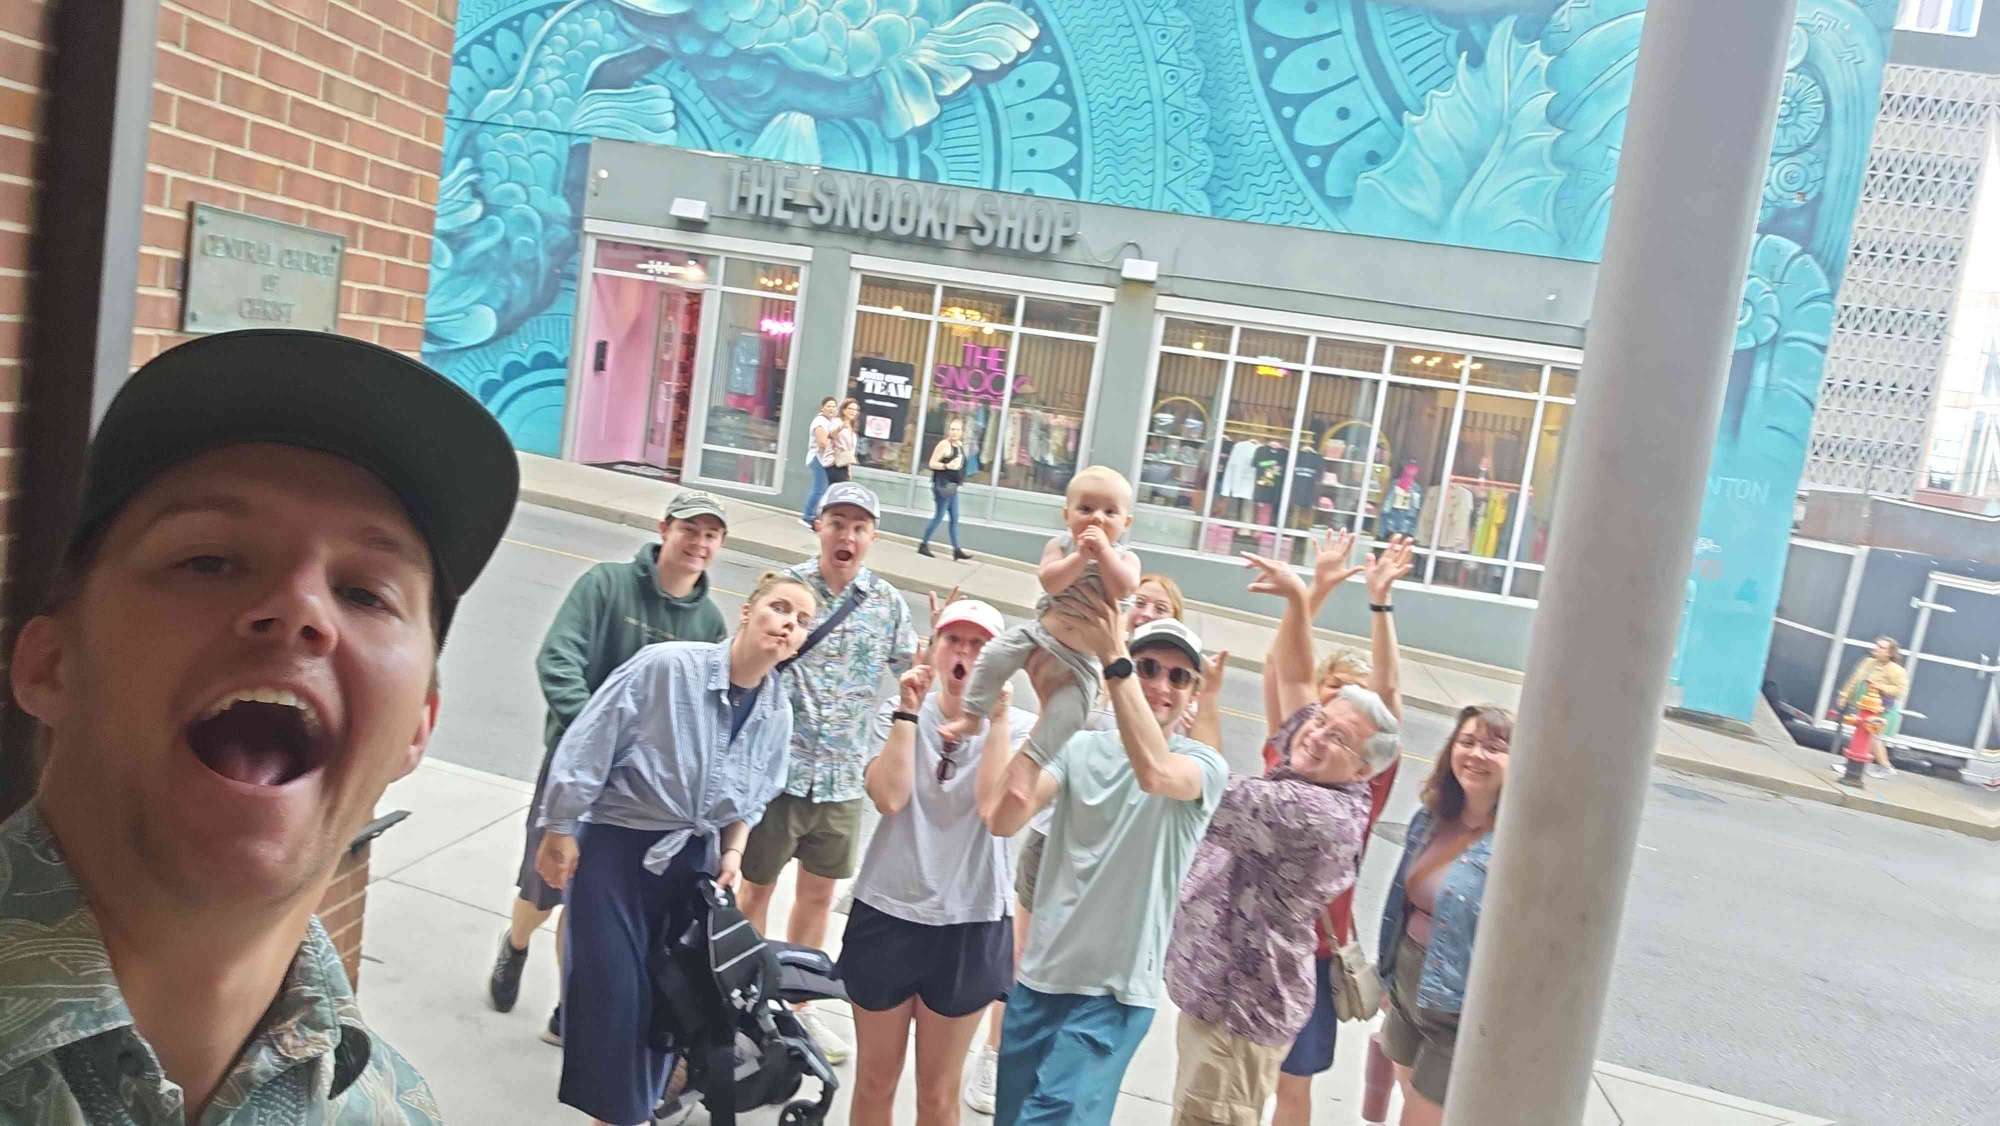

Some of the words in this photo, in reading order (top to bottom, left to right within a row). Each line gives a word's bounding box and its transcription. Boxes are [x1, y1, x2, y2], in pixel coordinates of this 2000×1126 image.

[728, 162, 797, 220] THE
[808, 173, 961, 242] SNOOKI
[969, 194, 1081, 255] SHOP
[962, 343, 1007, 372] THE
[863, 379, 913, 400] TEAM
